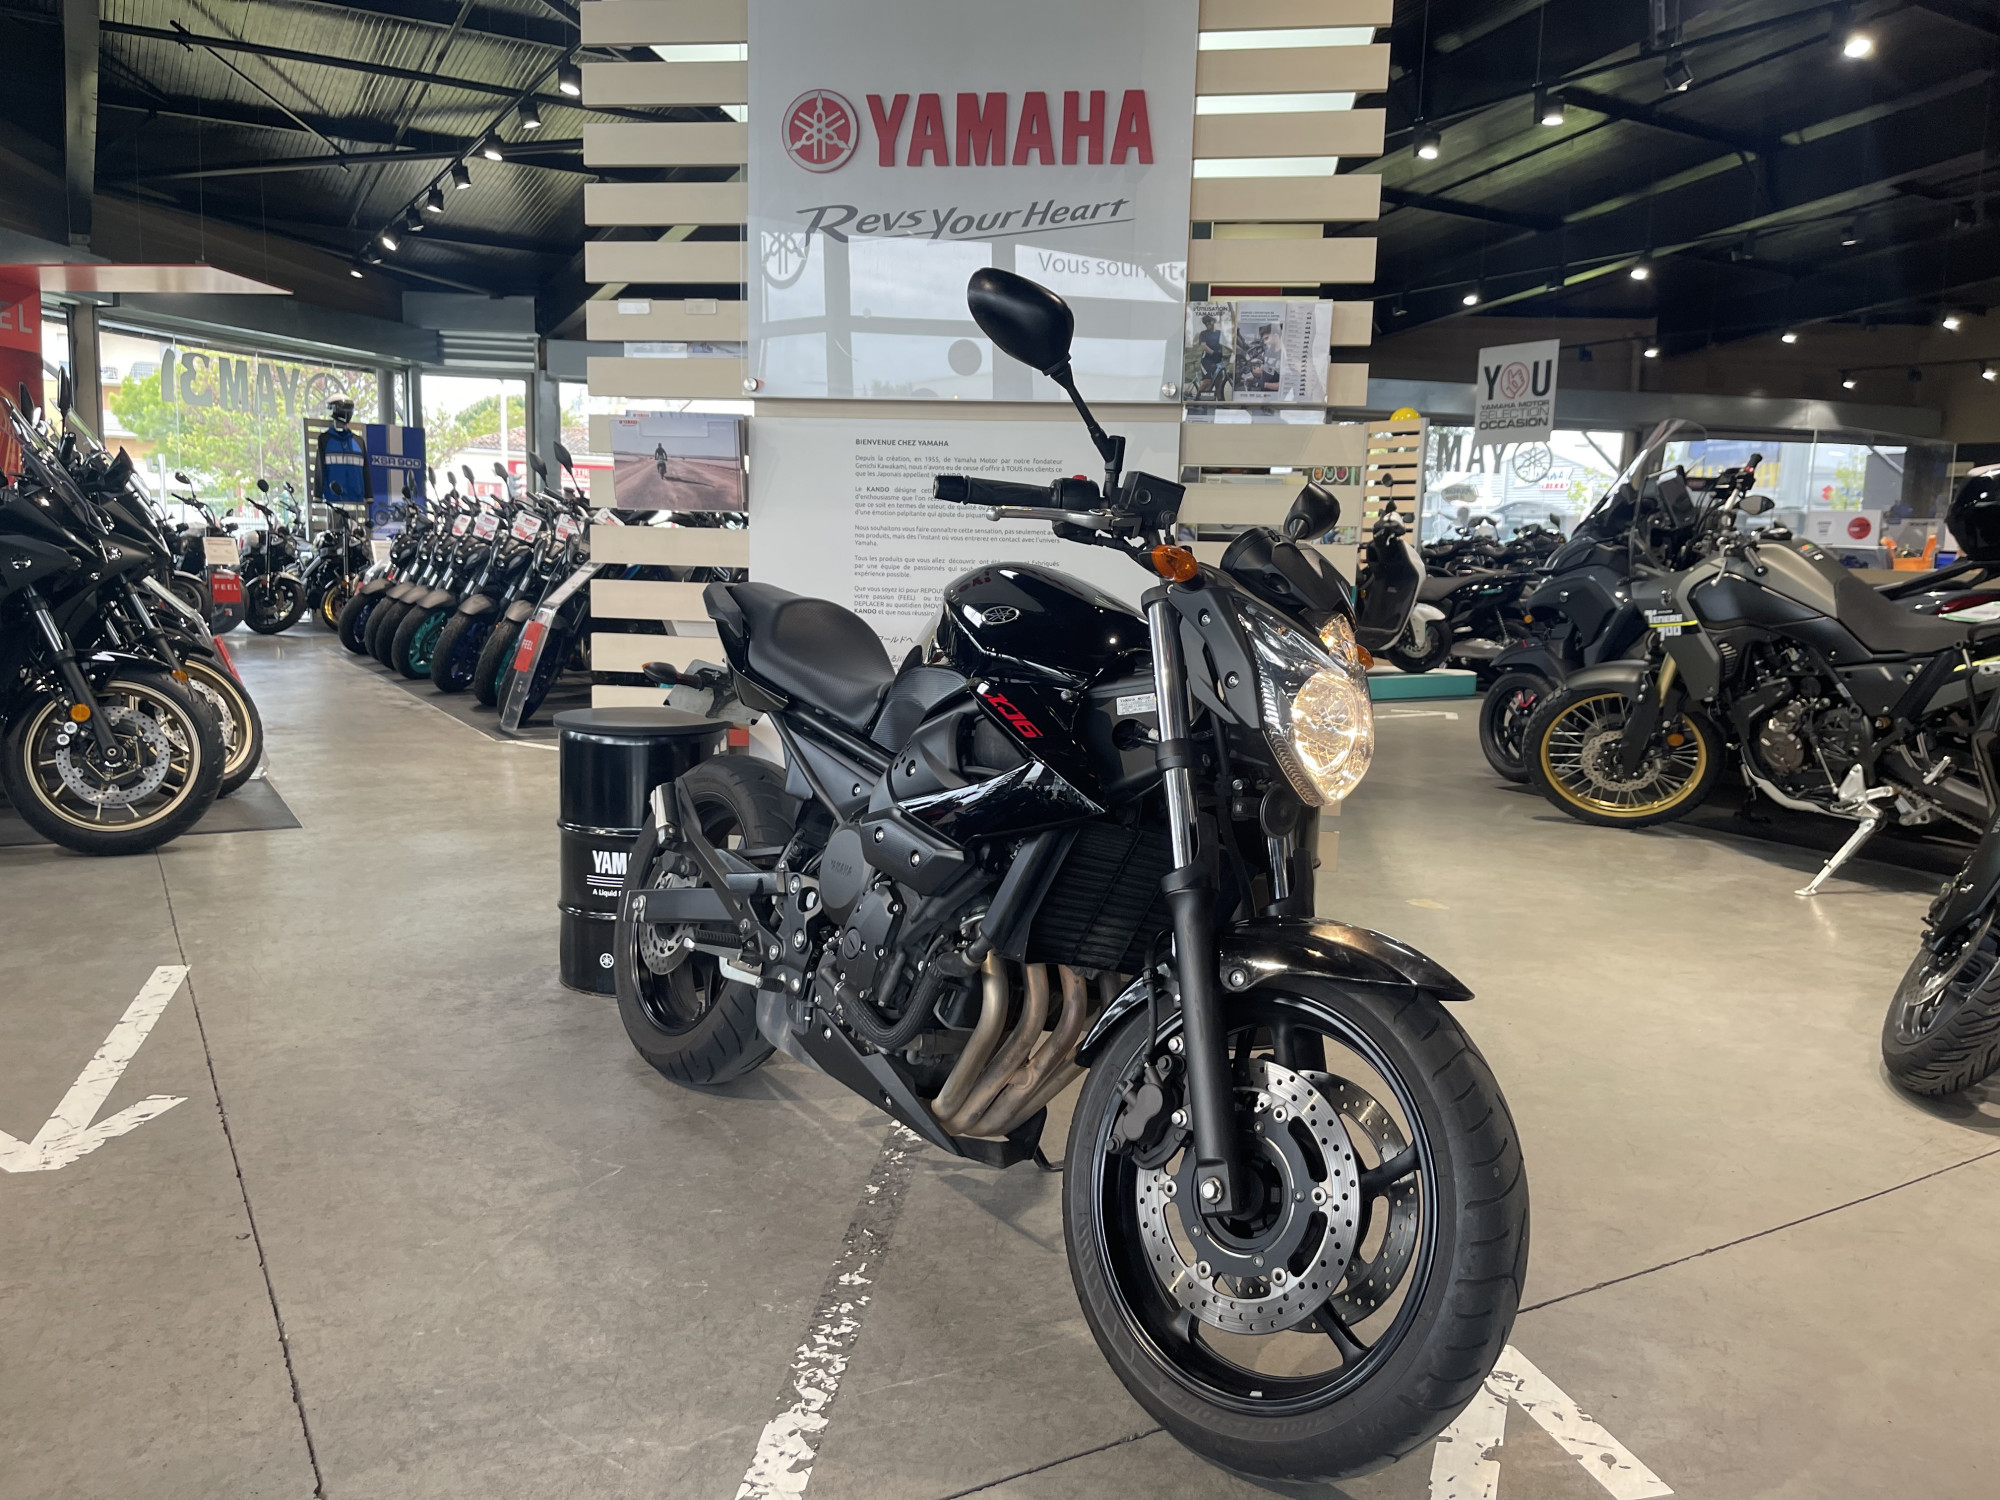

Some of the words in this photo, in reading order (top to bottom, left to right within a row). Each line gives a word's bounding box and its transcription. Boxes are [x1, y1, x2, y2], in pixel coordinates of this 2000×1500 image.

[866, 90, 1154, 167] YAMAHA
[795, 204, 927, 247] Revs
[928, 206, 1023, 245] Your
[1022, 198, 1131, 228] Heart
[1038, 252, 1090, 275] Vous
[1481, 402, 1516, 410] YAMAHA
[1519, 399, 1550, 407] MOTOR
[1480, 406, 1550, 420] SELECTION
[1479, 417, 1549, 430] OCCASION
[877, 463, 907, 471] Kawakami,
[897, 510, 926, 518] palpitante
[974, 527, 1003, 536] sensation,
[879, 556, 903, 564] produits
[914, 564, 945, 572] passionnés
[854, 570, 885, 578] expérience
[872, 594, 894, 602] passion
[894, 602, 921, 610] quotidien
[592, 850, 632, 875] YAM
[592, 888, 598, 896] A
[598, 889, 618, 897] Liquid
